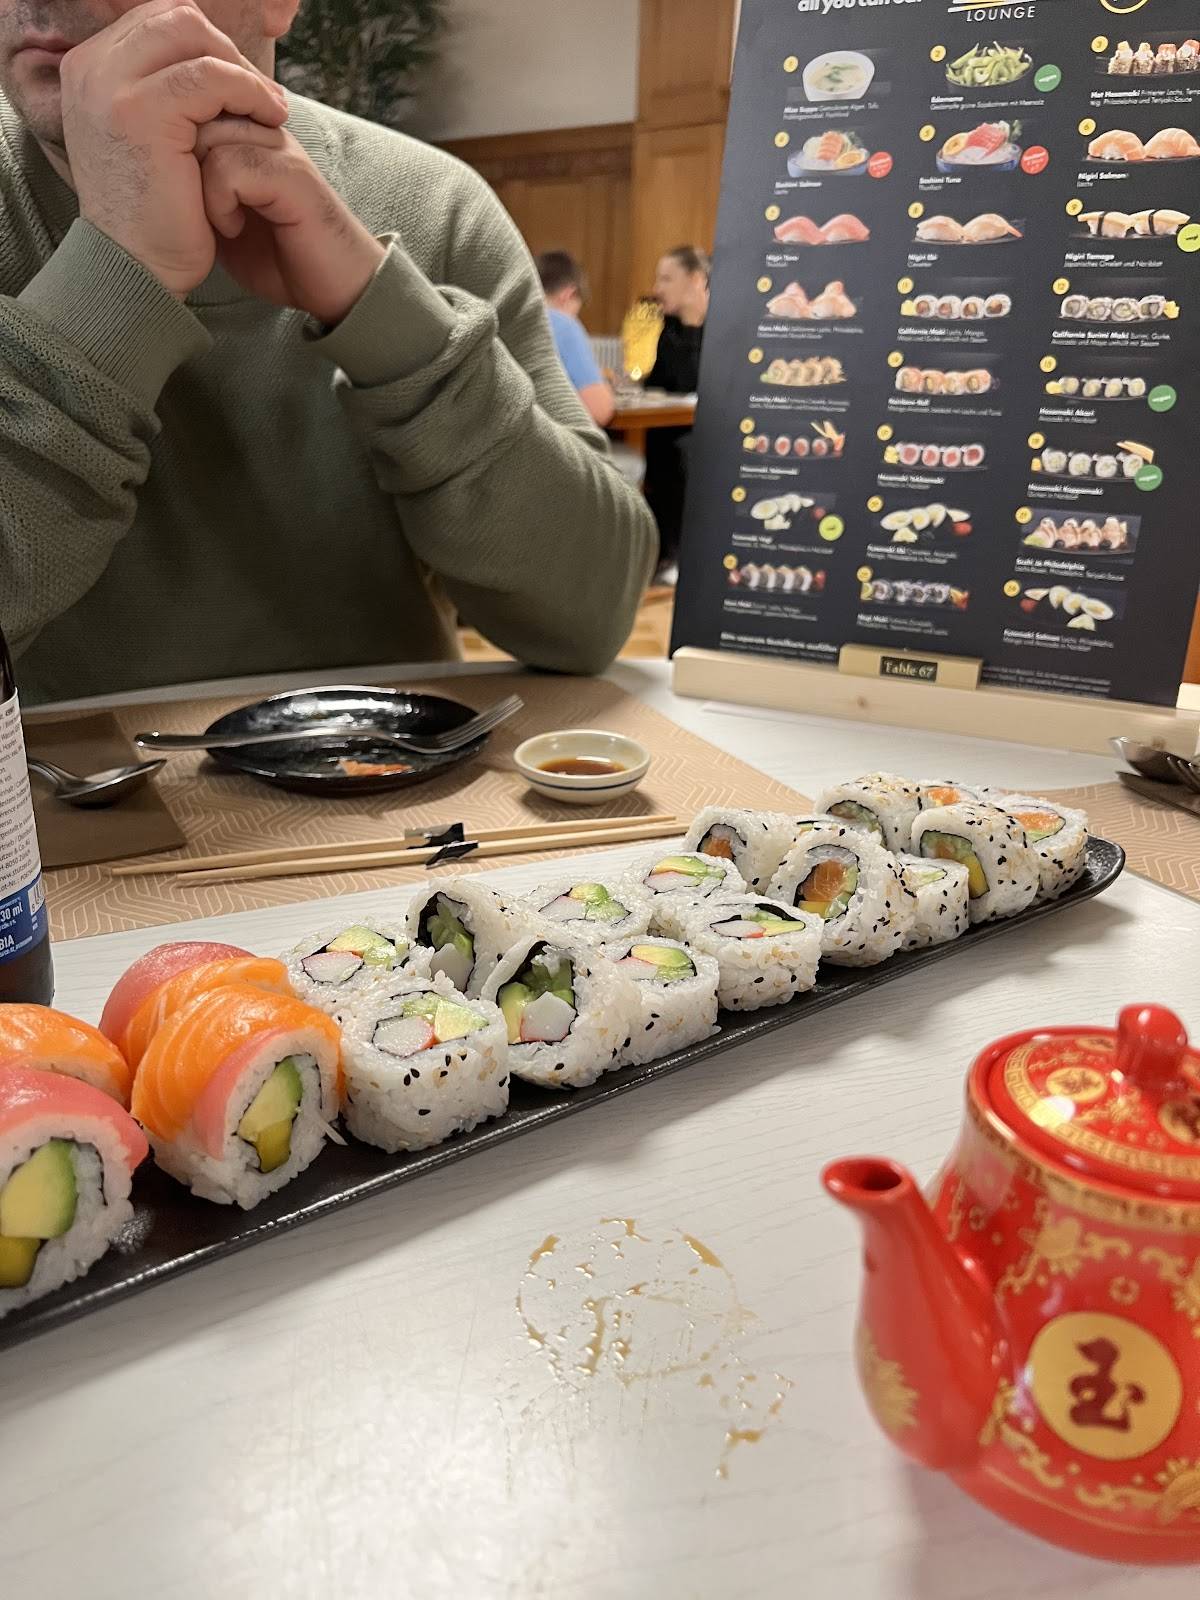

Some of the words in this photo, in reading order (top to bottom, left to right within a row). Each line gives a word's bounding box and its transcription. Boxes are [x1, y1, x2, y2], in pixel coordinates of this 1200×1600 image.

[966, 6, 1036, 22] LOUNGE
[883, 661, 917, 677] Table
[918, 665, 935, 679] 67
[12, 901, 23, 917] ml
